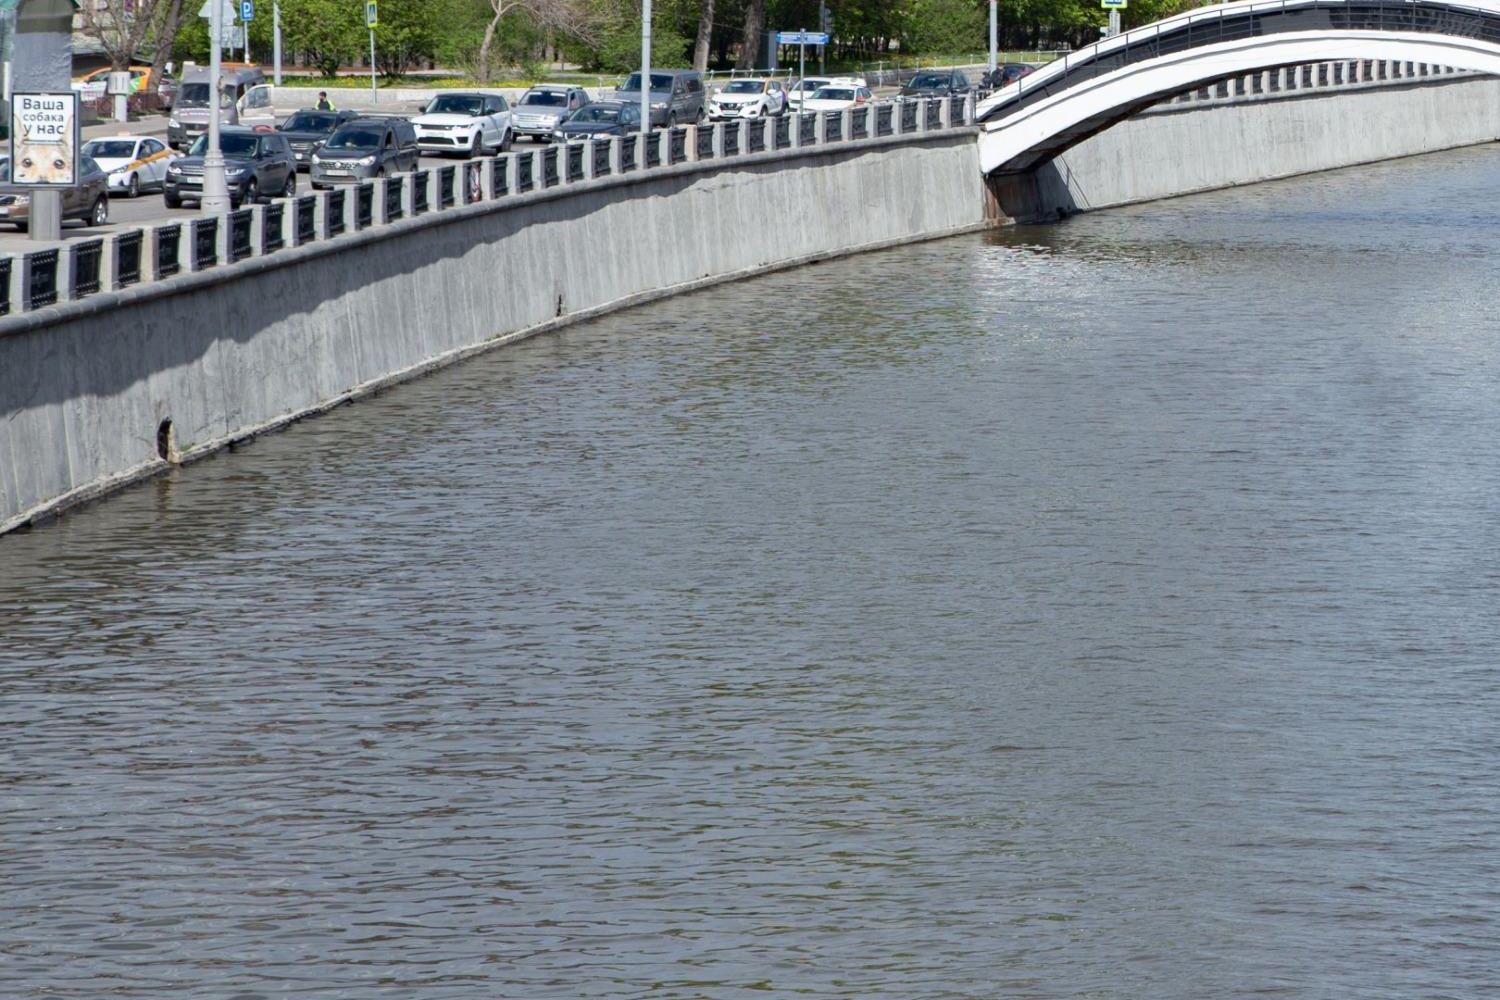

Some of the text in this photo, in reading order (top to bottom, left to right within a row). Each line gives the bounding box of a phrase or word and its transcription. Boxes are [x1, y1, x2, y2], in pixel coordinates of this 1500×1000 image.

[23, 98, 64, 110] Ваша
[23, 112, 64, 122] собака
[23, 124, 64, 137] у нас
